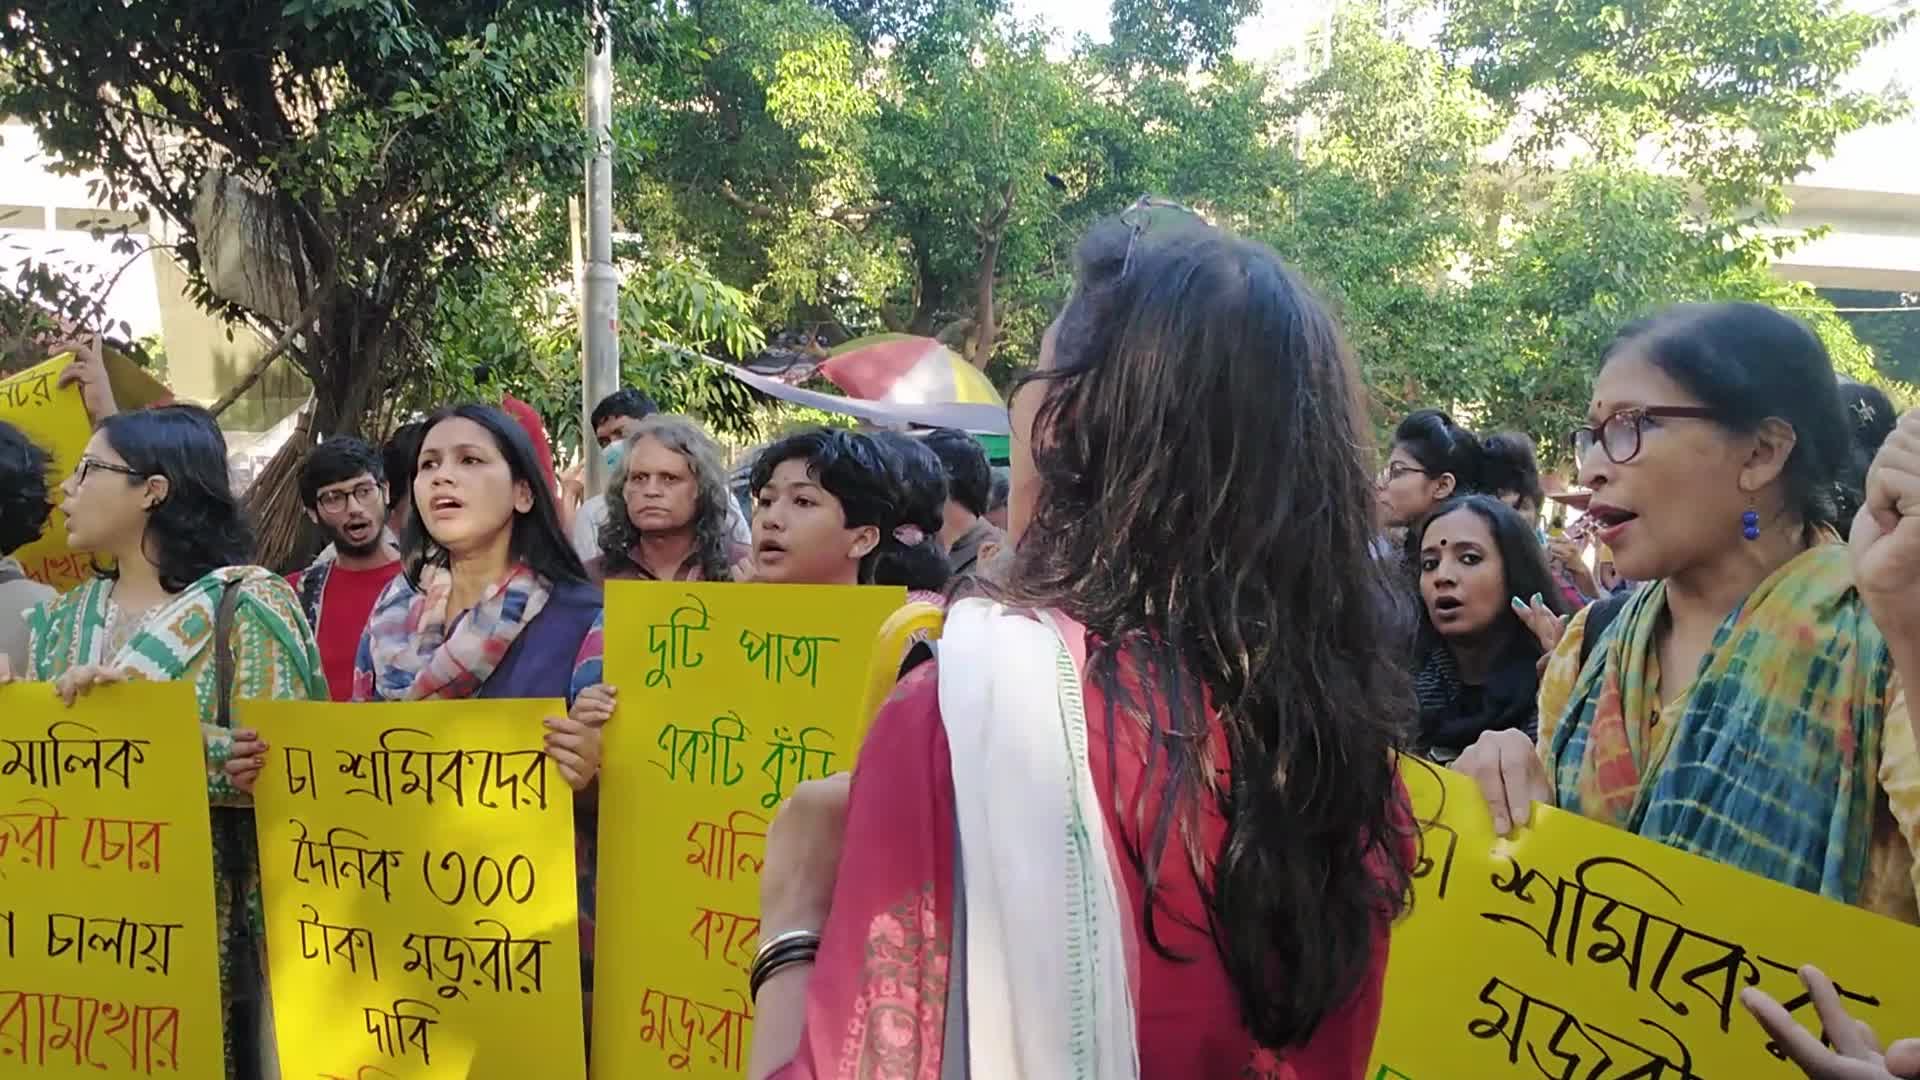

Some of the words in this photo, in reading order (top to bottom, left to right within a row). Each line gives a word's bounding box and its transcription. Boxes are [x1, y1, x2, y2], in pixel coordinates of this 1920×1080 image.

[645, 593, 715, 688] দুটি
[739, 629, 840, 688] পাতা
[1, 721, 151, 789] মালিক
[283, 747, 319, 801] চা
[335, 728, 549, 811] শ্রমিকদের
[648, 709, 752, 786] একটি
[81, 818, 171, 874] চোর
[288, 818, 403, 903] দৈনিক
[423, 849, 536, 906] ৩০০
[686, 810, 768, 881] মালি
[48, 913, 183, 976] চালায়
[298, 904, 379, 982] টাকা
[0, 990, 179, 1076] রামখোর
[363, 998, 441, 1066] দাবি
